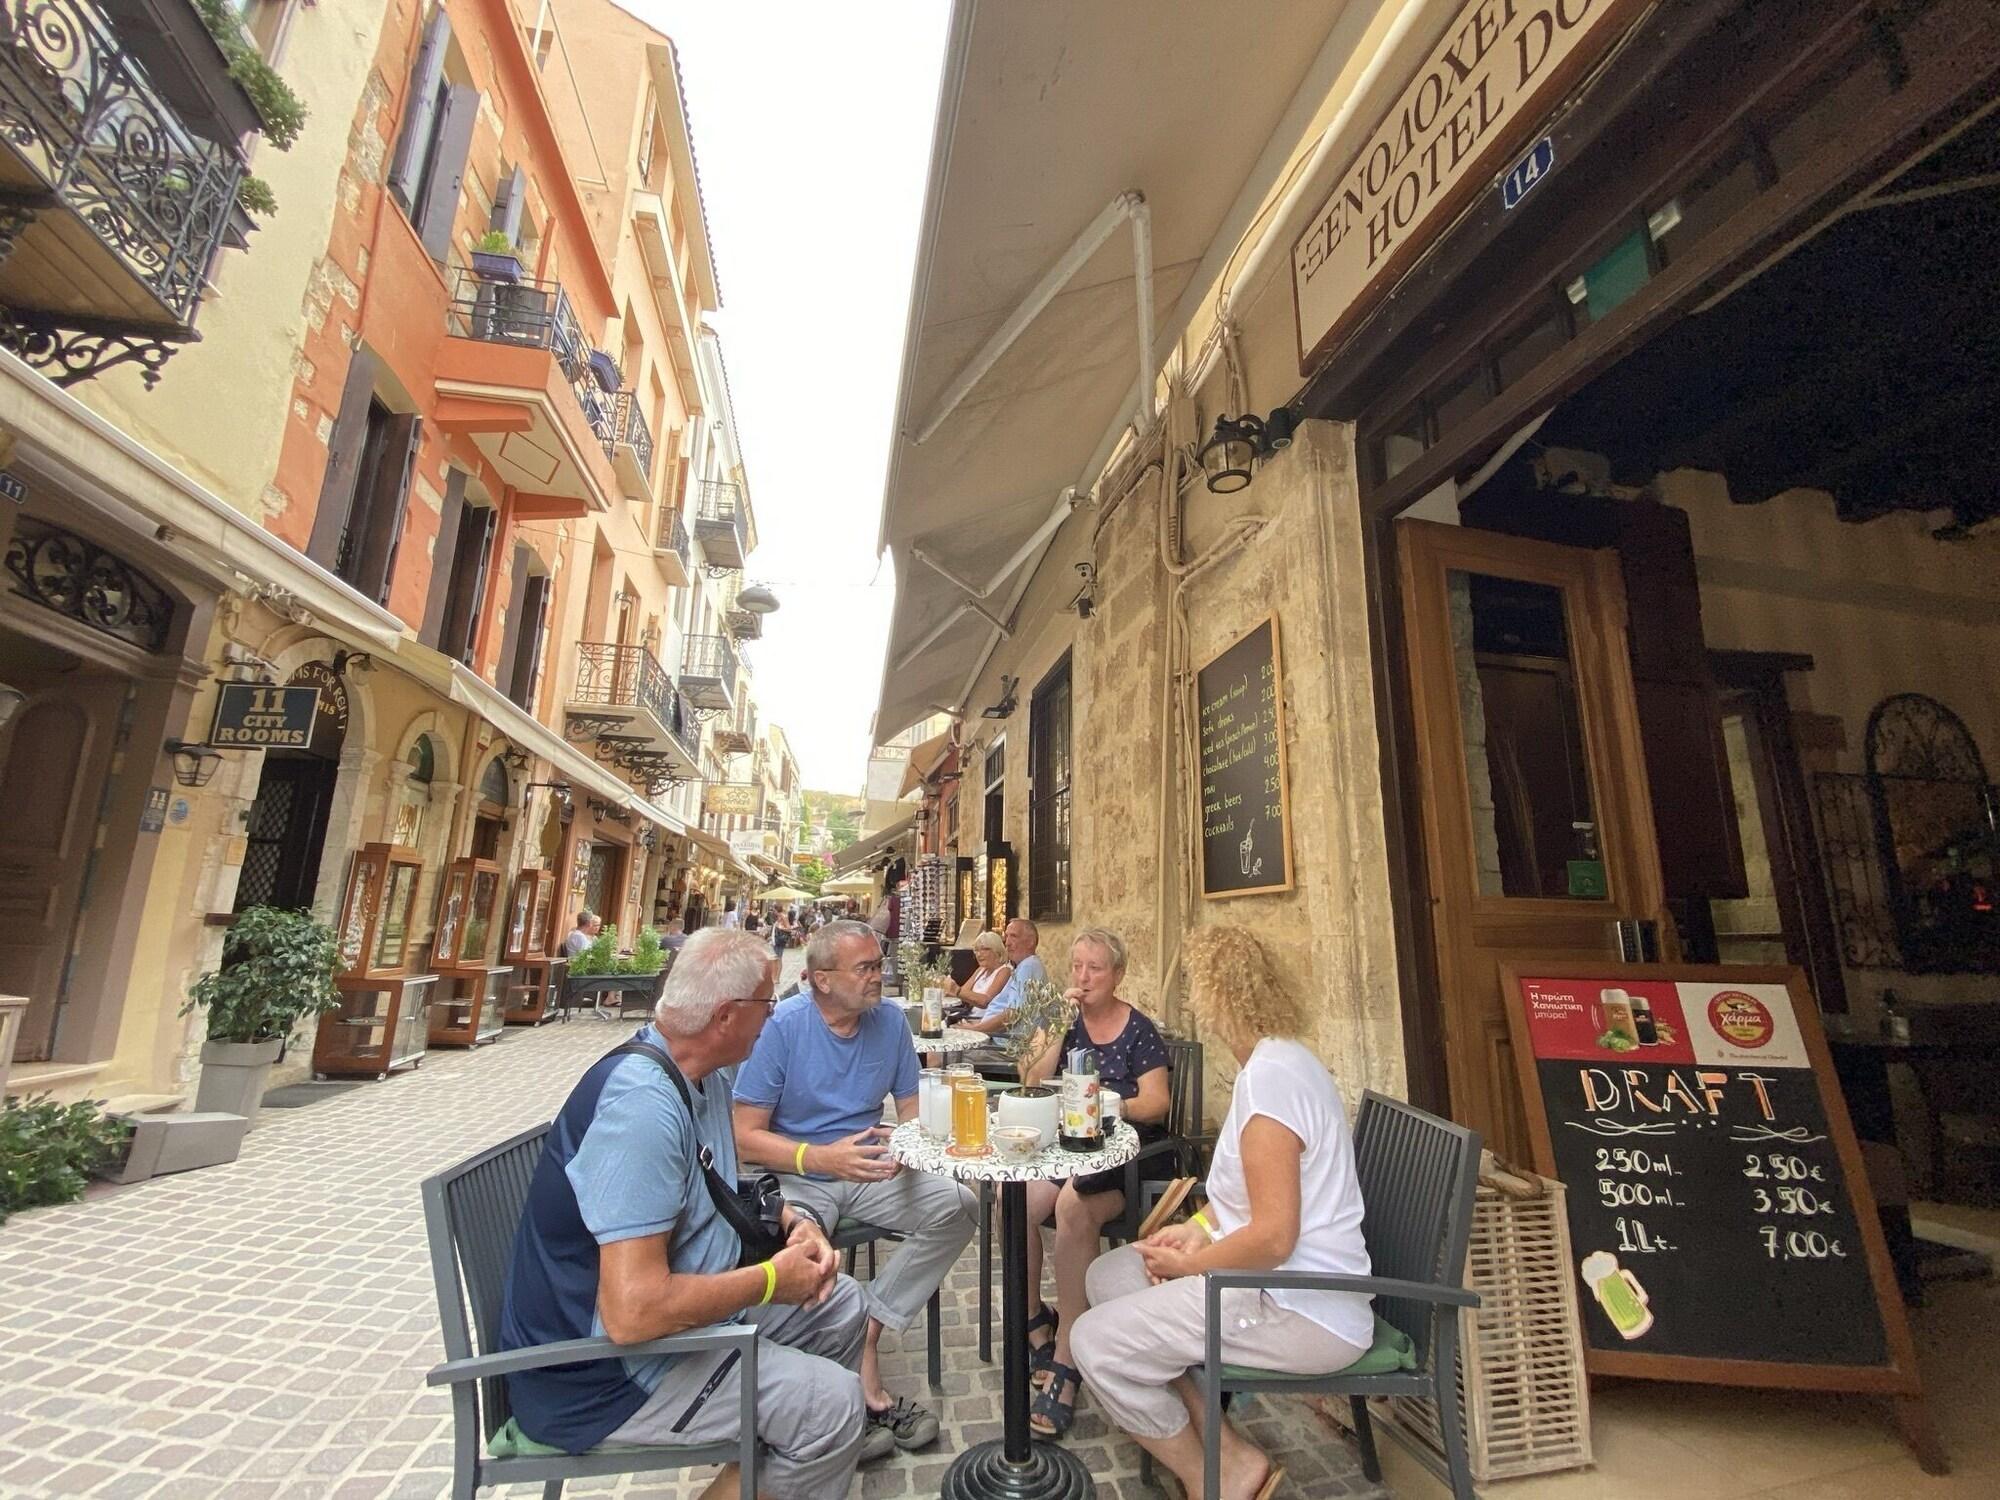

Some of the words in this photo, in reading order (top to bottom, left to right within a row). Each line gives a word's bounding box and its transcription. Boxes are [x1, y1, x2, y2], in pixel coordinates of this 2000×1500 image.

[1366, 73, 1504, 270] HOTEL
[1513, 153, 1539, 196] 14
[6, 481, 22, 499] 11
[313, 666, 336, 692] FOR
[249, 688, 286, 713] 11
[242, 715, 288, 728] CITY
[218, 728, 304, 744] ROOMS
[1224, 792, 1242, 809] beers
[1205, 813, 1234, 838] cocktails
[1530, 992, 1539, 1000] Η
[1540, 992, 1575, 1003] πρώτη
[1531, 1001, 1584, 1013] Χανιώτικη
[1580, 1069, 1778, 1120] DRAFT
